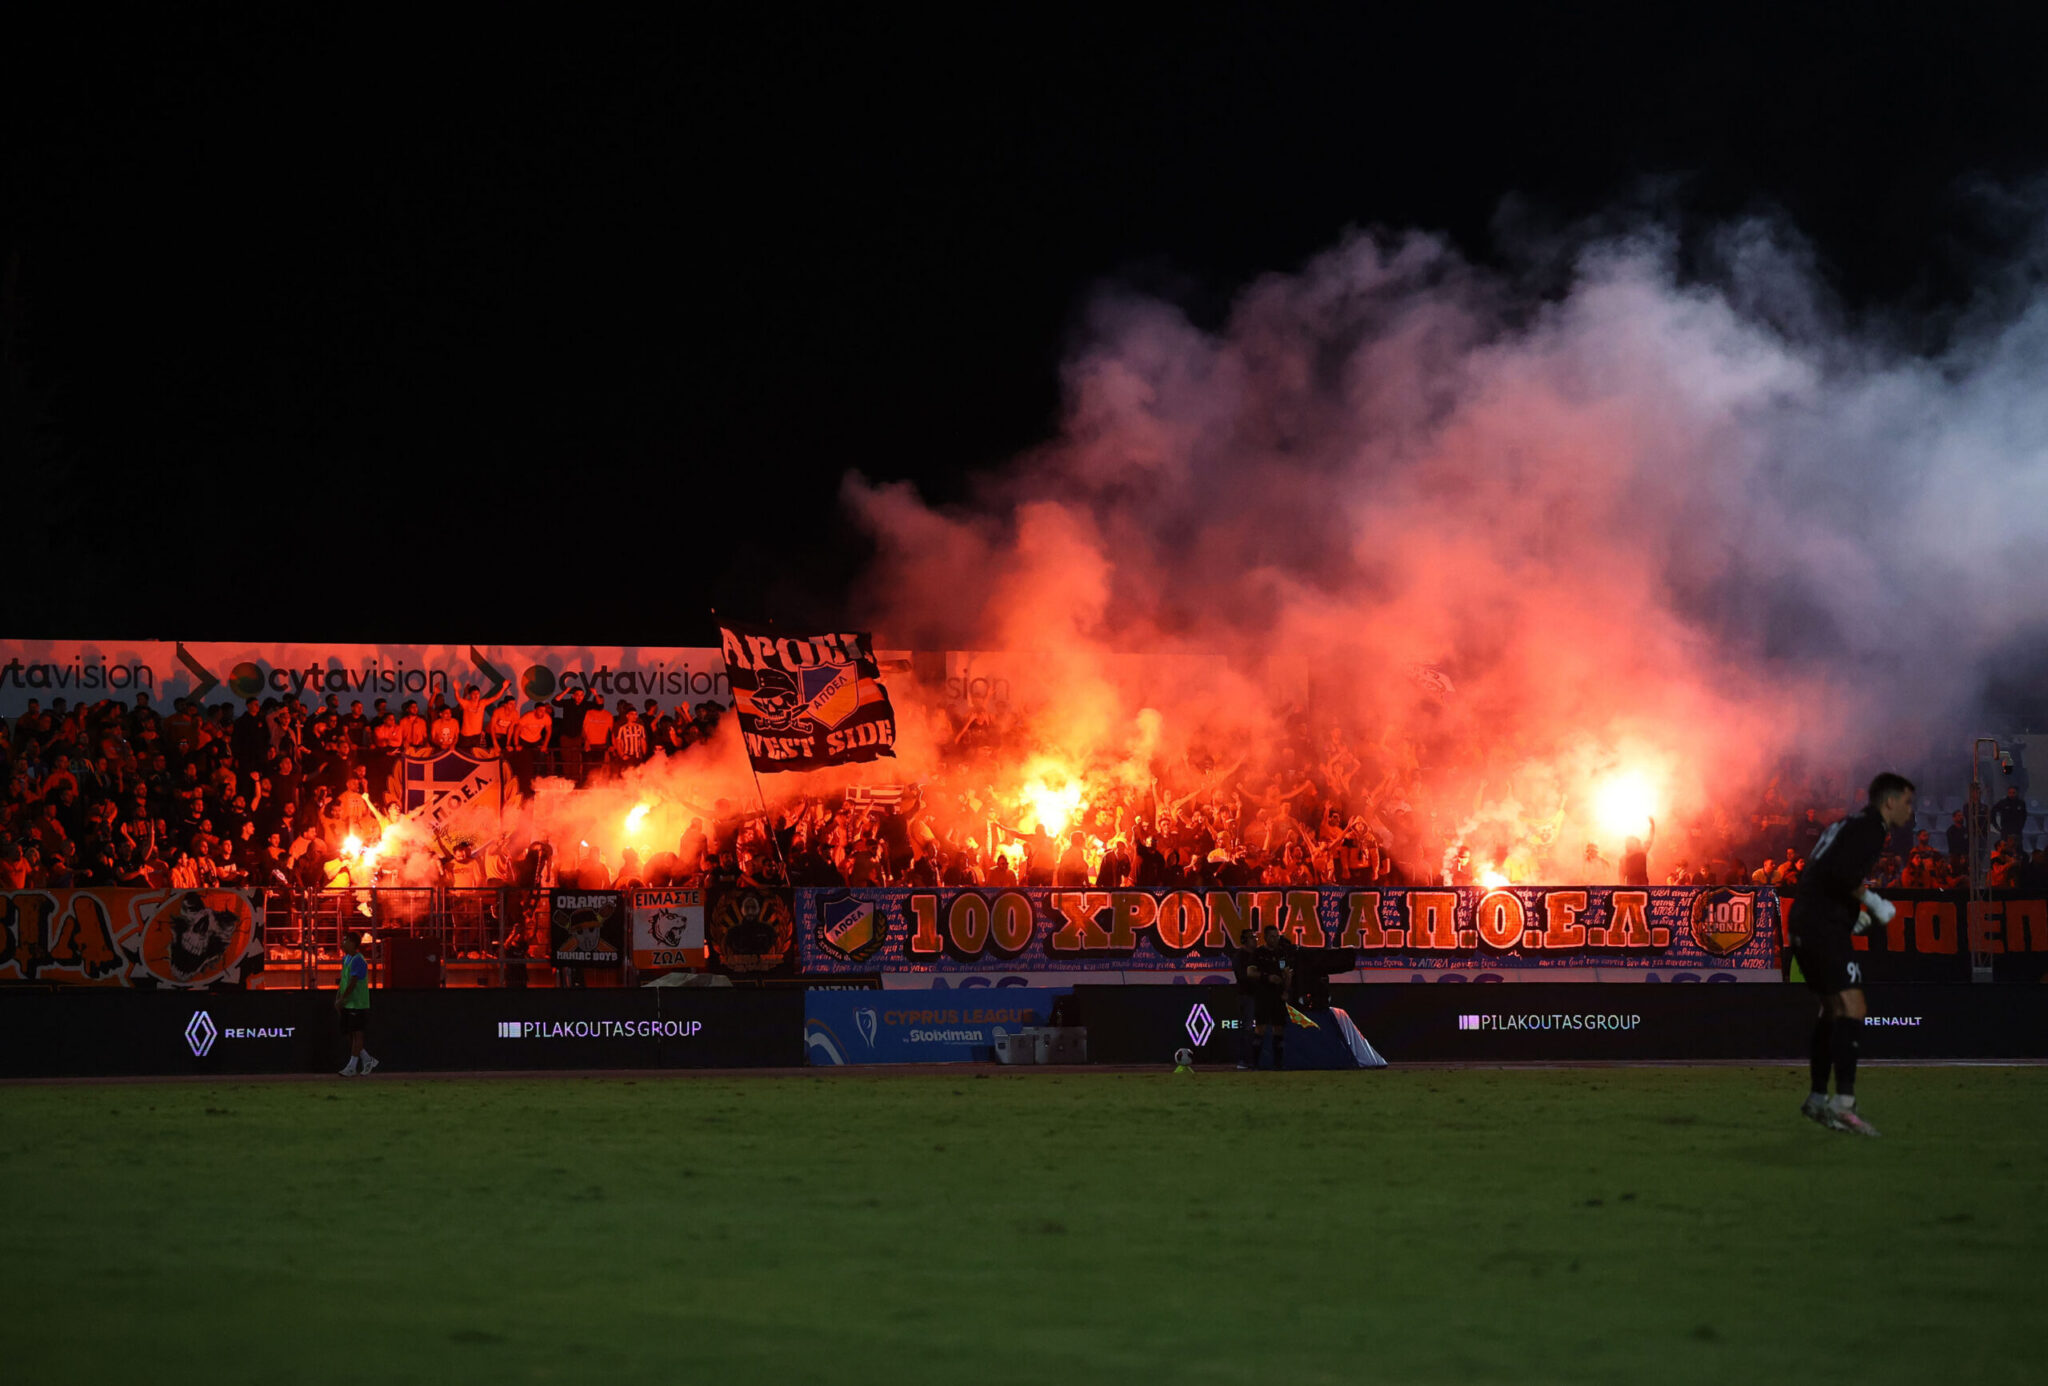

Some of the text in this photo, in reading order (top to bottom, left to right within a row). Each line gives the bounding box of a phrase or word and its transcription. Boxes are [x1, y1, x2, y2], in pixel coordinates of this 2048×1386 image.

[268, 660, 448, 699] cytavision
[559, 663, 732, 701] cytavision
[947, 668, 1010, 701] sion
[814, 675, 848, 710] ΑΠΟΕΛ
[826, 719, 893, 756] SIDE
[635, 889, 700, 907] ΕΙΜΑΣΤΕ
[911, 891, 1033, 953] 100
[1050, 891, 1326, 950] ΧΡΟΝΙΑ
[1339, 890, 1669, 950] Α.Π.Ο.Ε.Λ.
[1707, 902, 1746, 923] 100
[833, 909, 865, 938] ΑΠΟΕΛ
[652, 950, 686, 965] ΖΩΑ
[883, 1007, 1034, 1026] CYPRUS LEAGUE
[1481, 1014, 1642, 1030] PILAKOUTASGROUP
[1864, 1016, 1923, 1027] RENAULT
[224, 1027, 296, 1039] RENAULT
[523, 1020, 703, 1038] PILAKOUTASGROUP
[910, 1028, 983, 1043] Stoiximan
